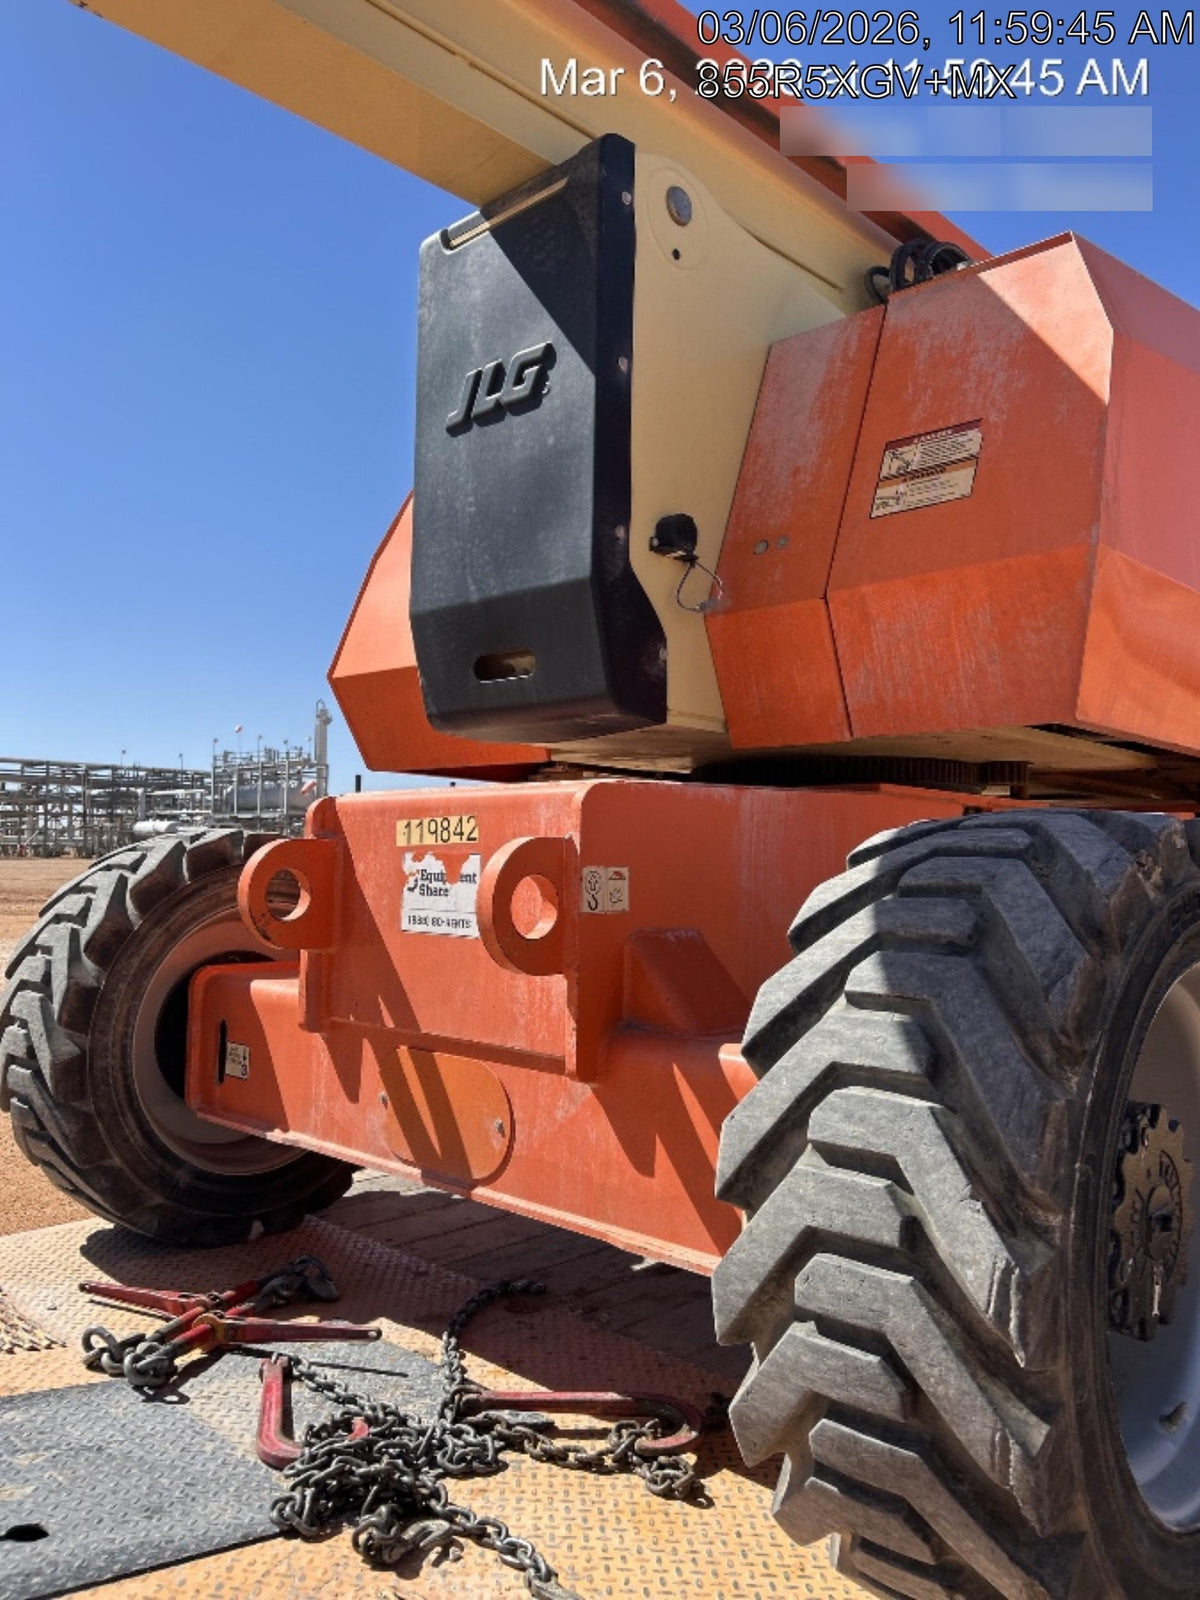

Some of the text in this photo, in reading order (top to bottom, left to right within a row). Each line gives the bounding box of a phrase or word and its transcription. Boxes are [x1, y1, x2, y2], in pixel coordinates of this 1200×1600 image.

[446, 341, 557, 438] JLG
[404, 815, 478, 845] 119842
[420, 868, 477, 885] Equient
[419, 882, 449, 897] Share
